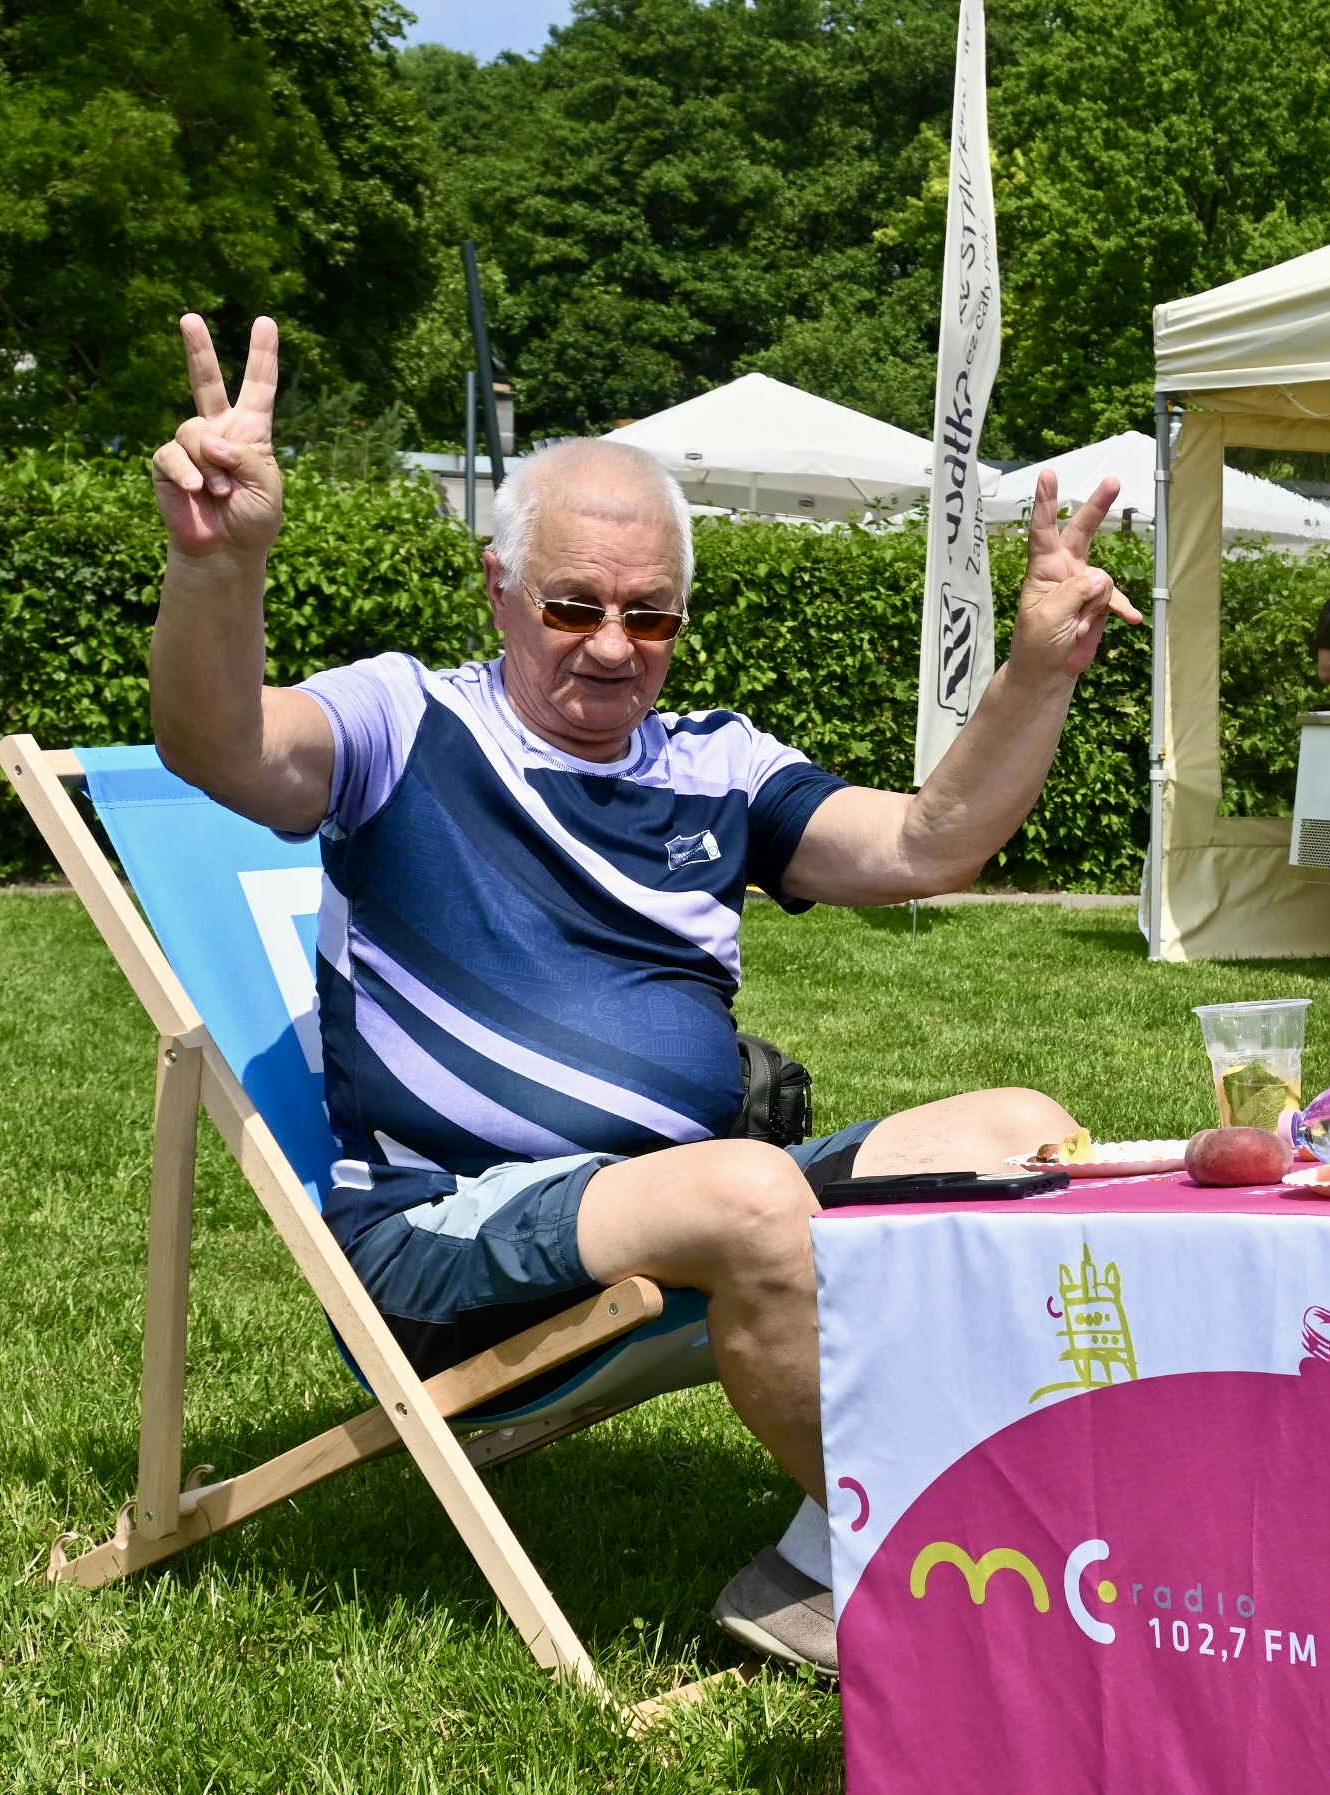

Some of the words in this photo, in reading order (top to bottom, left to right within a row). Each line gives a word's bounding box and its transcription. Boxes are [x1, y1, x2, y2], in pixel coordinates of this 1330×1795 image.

[1130, 1580, 1256, 1619] radio
[1148, 1616, 1247, 1663] 102,7
[1264, 1628, 1319, 1668] FM
